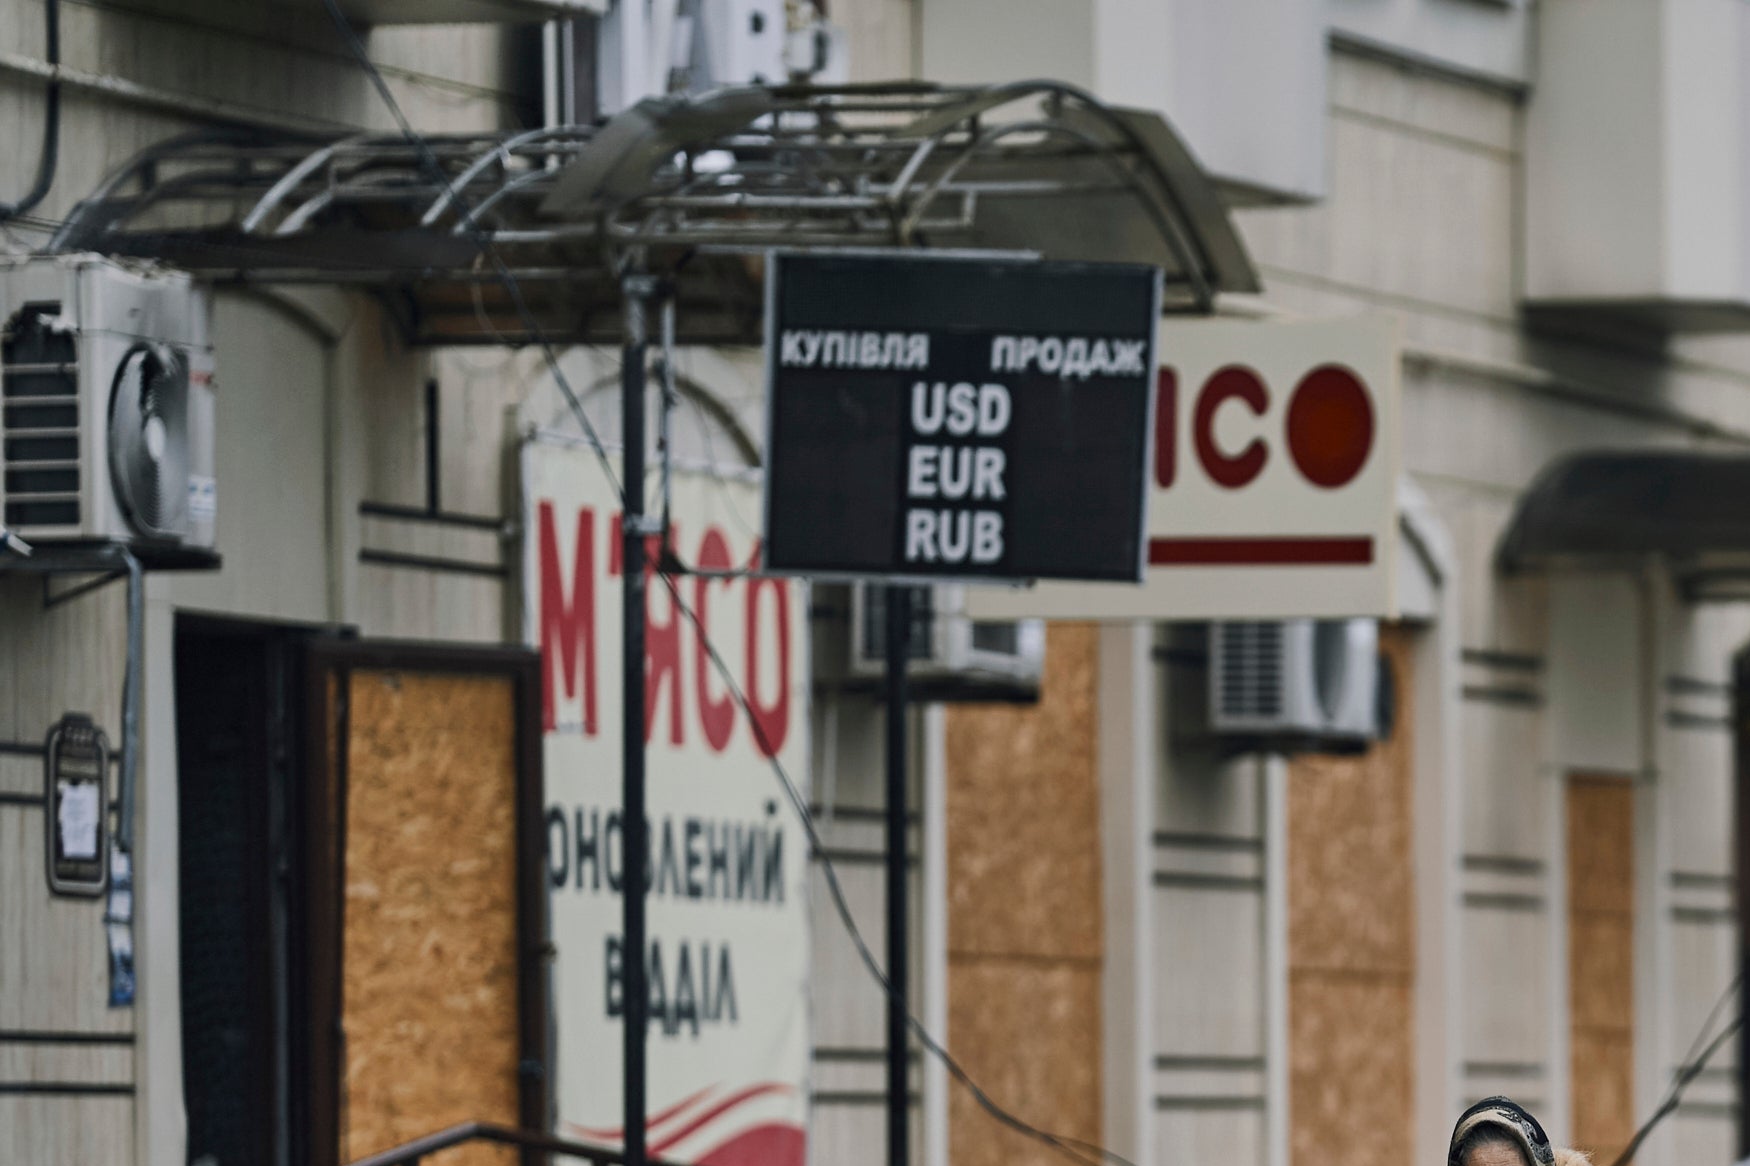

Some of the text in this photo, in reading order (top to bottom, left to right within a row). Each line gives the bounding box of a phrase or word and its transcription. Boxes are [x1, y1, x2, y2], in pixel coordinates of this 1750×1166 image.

[781, 330, 1146, 378] КУПІВЛЯ ПРОДАЖ
[911, 381, 1011, 436] USD
[1155, 364, 1375, 489] СО
[907, 444, 1006, 500] EUR
[905, 508, 1004, 563] RUB
[546, 799, 785, 904] ОНОЛЕНИЙ
[604, 935, 738, 1038] ВДДІЛ
